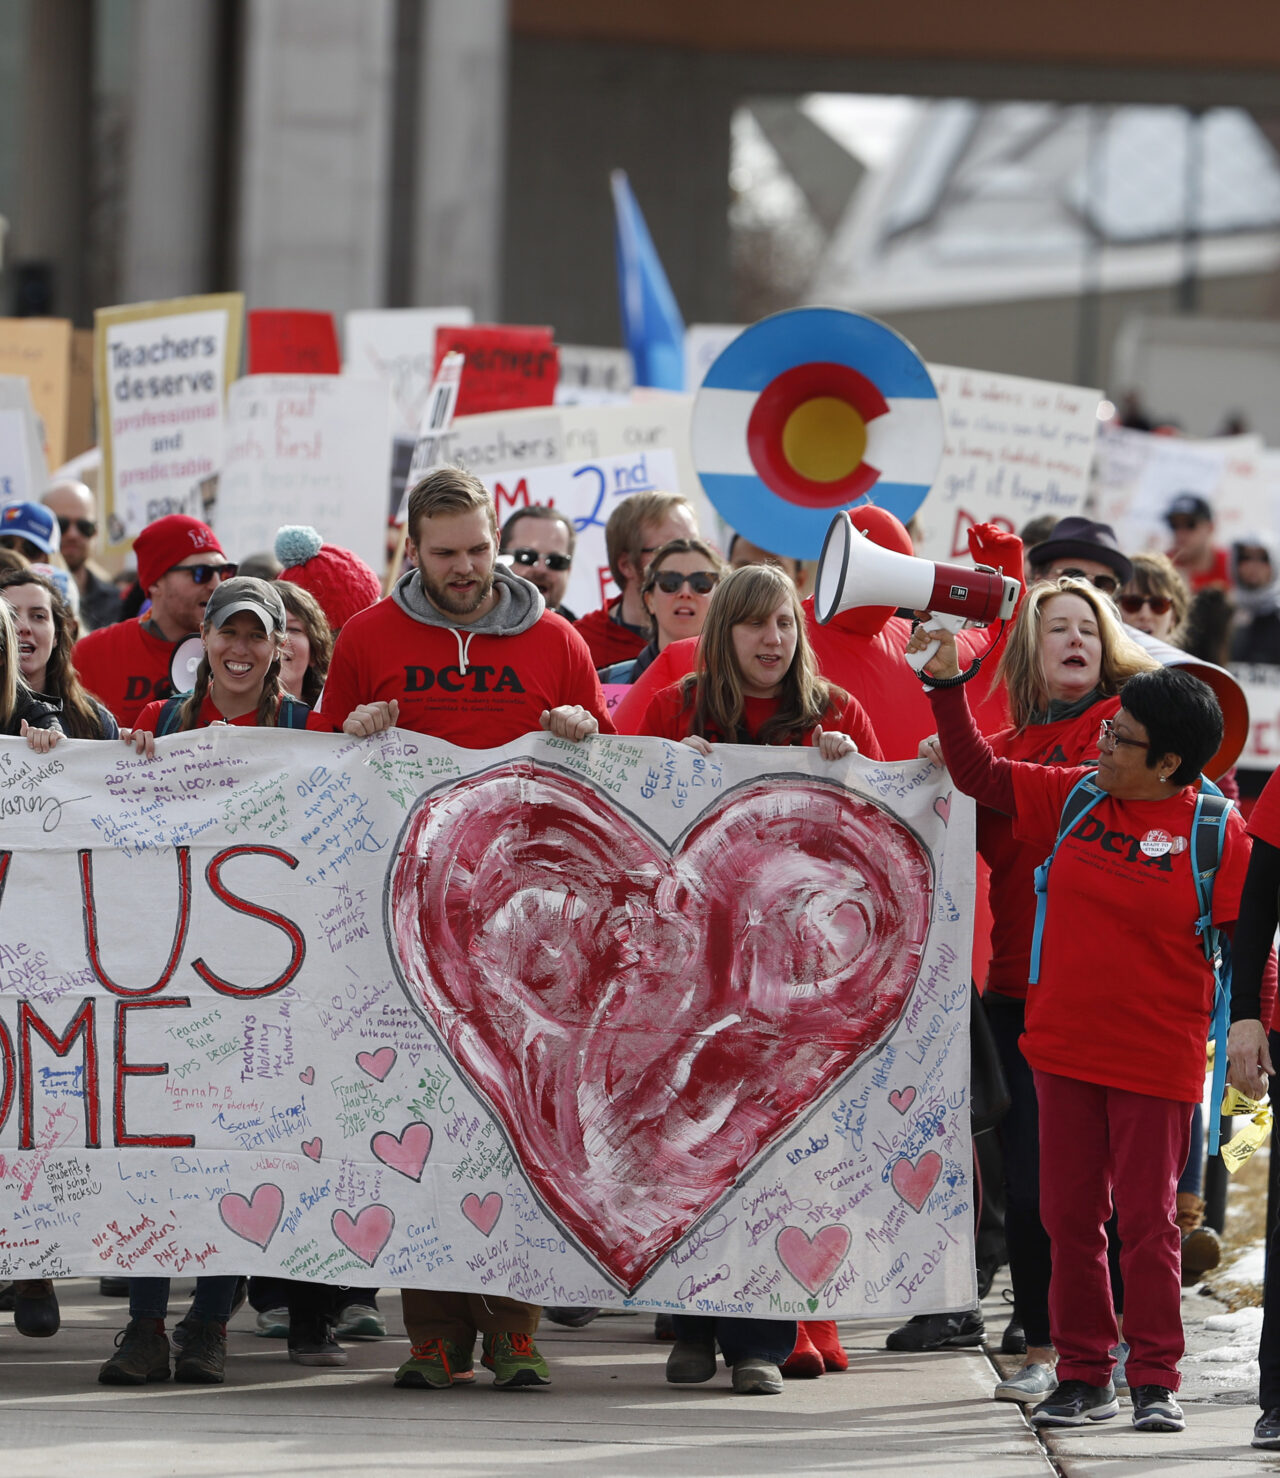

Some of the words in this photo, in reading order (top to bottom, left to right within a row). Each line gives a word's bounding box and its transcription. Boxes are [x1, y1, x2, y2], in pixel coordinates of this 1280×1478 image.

[108, 335, 215, 370] Teachers
[115, 370, 214, 401] deserve
[113, 403, 218, 436] professional
[152, 433, 183, 453] and
[120, 458, 214, 488] predictable
[573, 454, 650, 533] 2nd
[403, 665, 527, 693] DCTA
[0, 763, 33, 789] social
[78, 842, 306, 1000] US
[374, 1016, 420, 1028] madness
[380, 1004, 411, 1016] East
[165, 1008, 223, 1041] Teachers
[186, 1031, 217, 1050] Rule
[164, 1078, 221, 1097] Hannah
[769, 1295, 805, 1313] Mora
